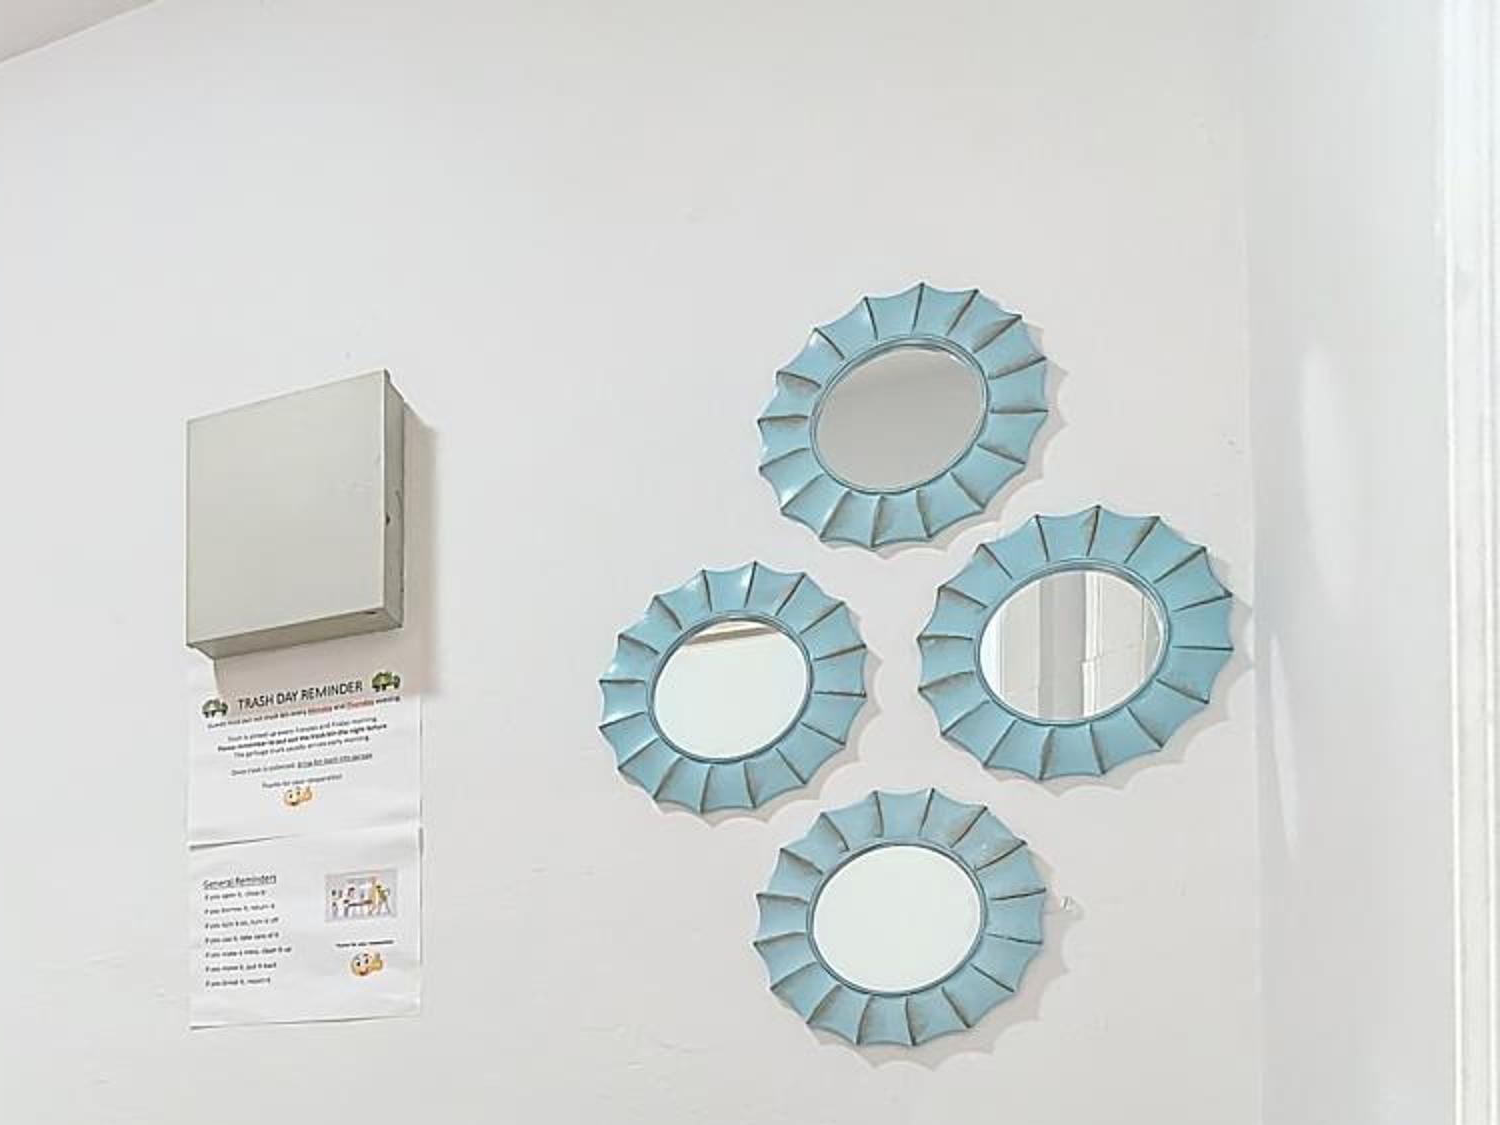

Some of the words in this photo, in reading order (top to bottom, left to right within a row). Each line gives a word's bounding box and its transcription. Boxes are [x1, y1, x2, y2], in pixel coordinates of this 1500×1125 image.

[238, 694, 275, 709] TRASH
[276, 690, 298, 704] DAY
[301, 681, 363, 700] REMINDER
[203, 879, 234, 890] General
[236, 875, 277, 888] Reminders
